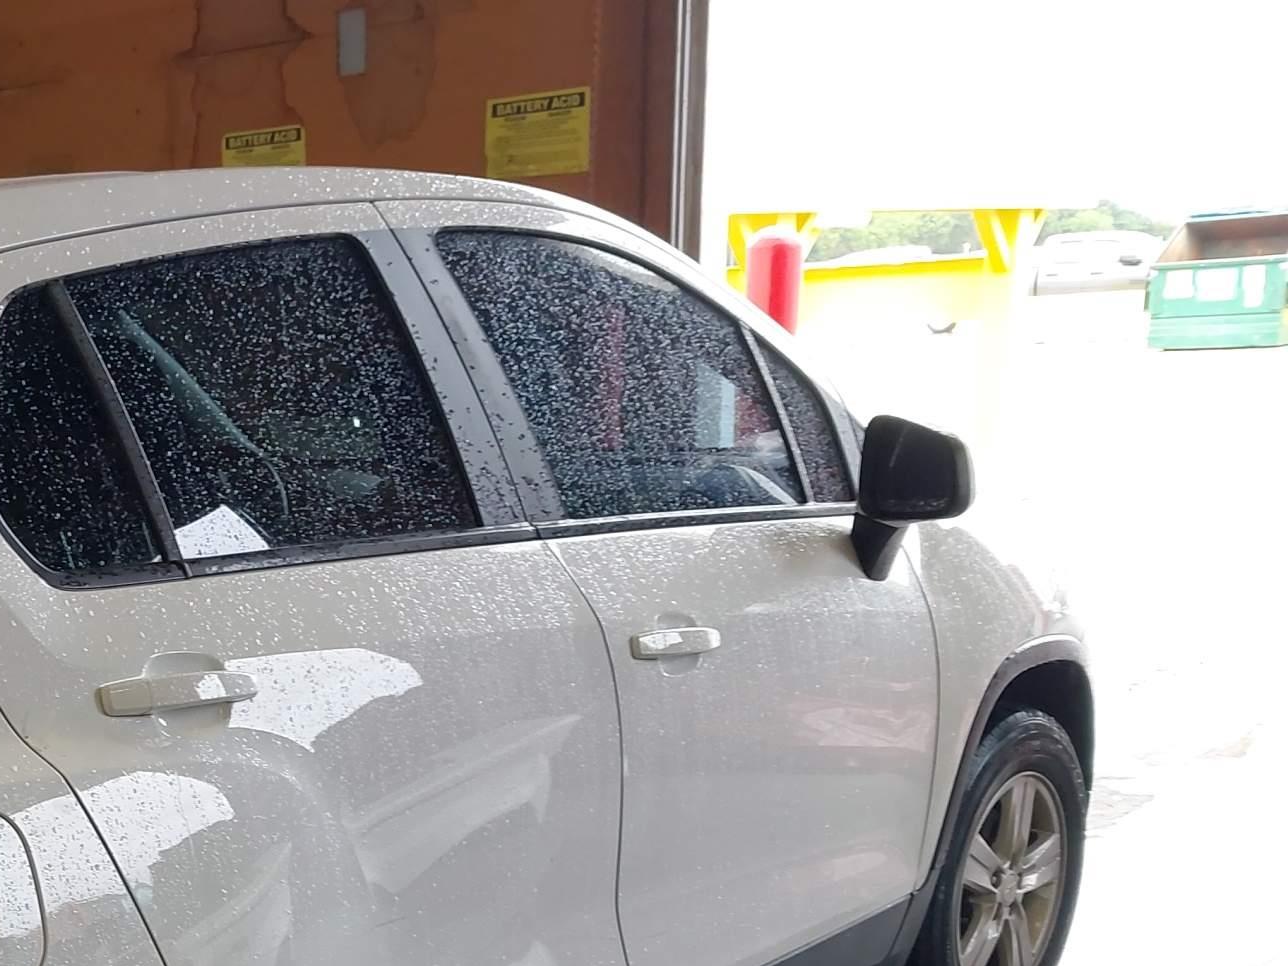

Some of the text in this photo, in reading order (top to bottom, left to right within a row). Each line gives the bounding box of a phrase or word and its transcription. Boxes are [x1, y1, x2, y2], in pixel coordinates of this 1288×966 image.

[495, 94, 581, 117] BATTERY ACID
[228, 129, 298, 149] BATTERY ACID
